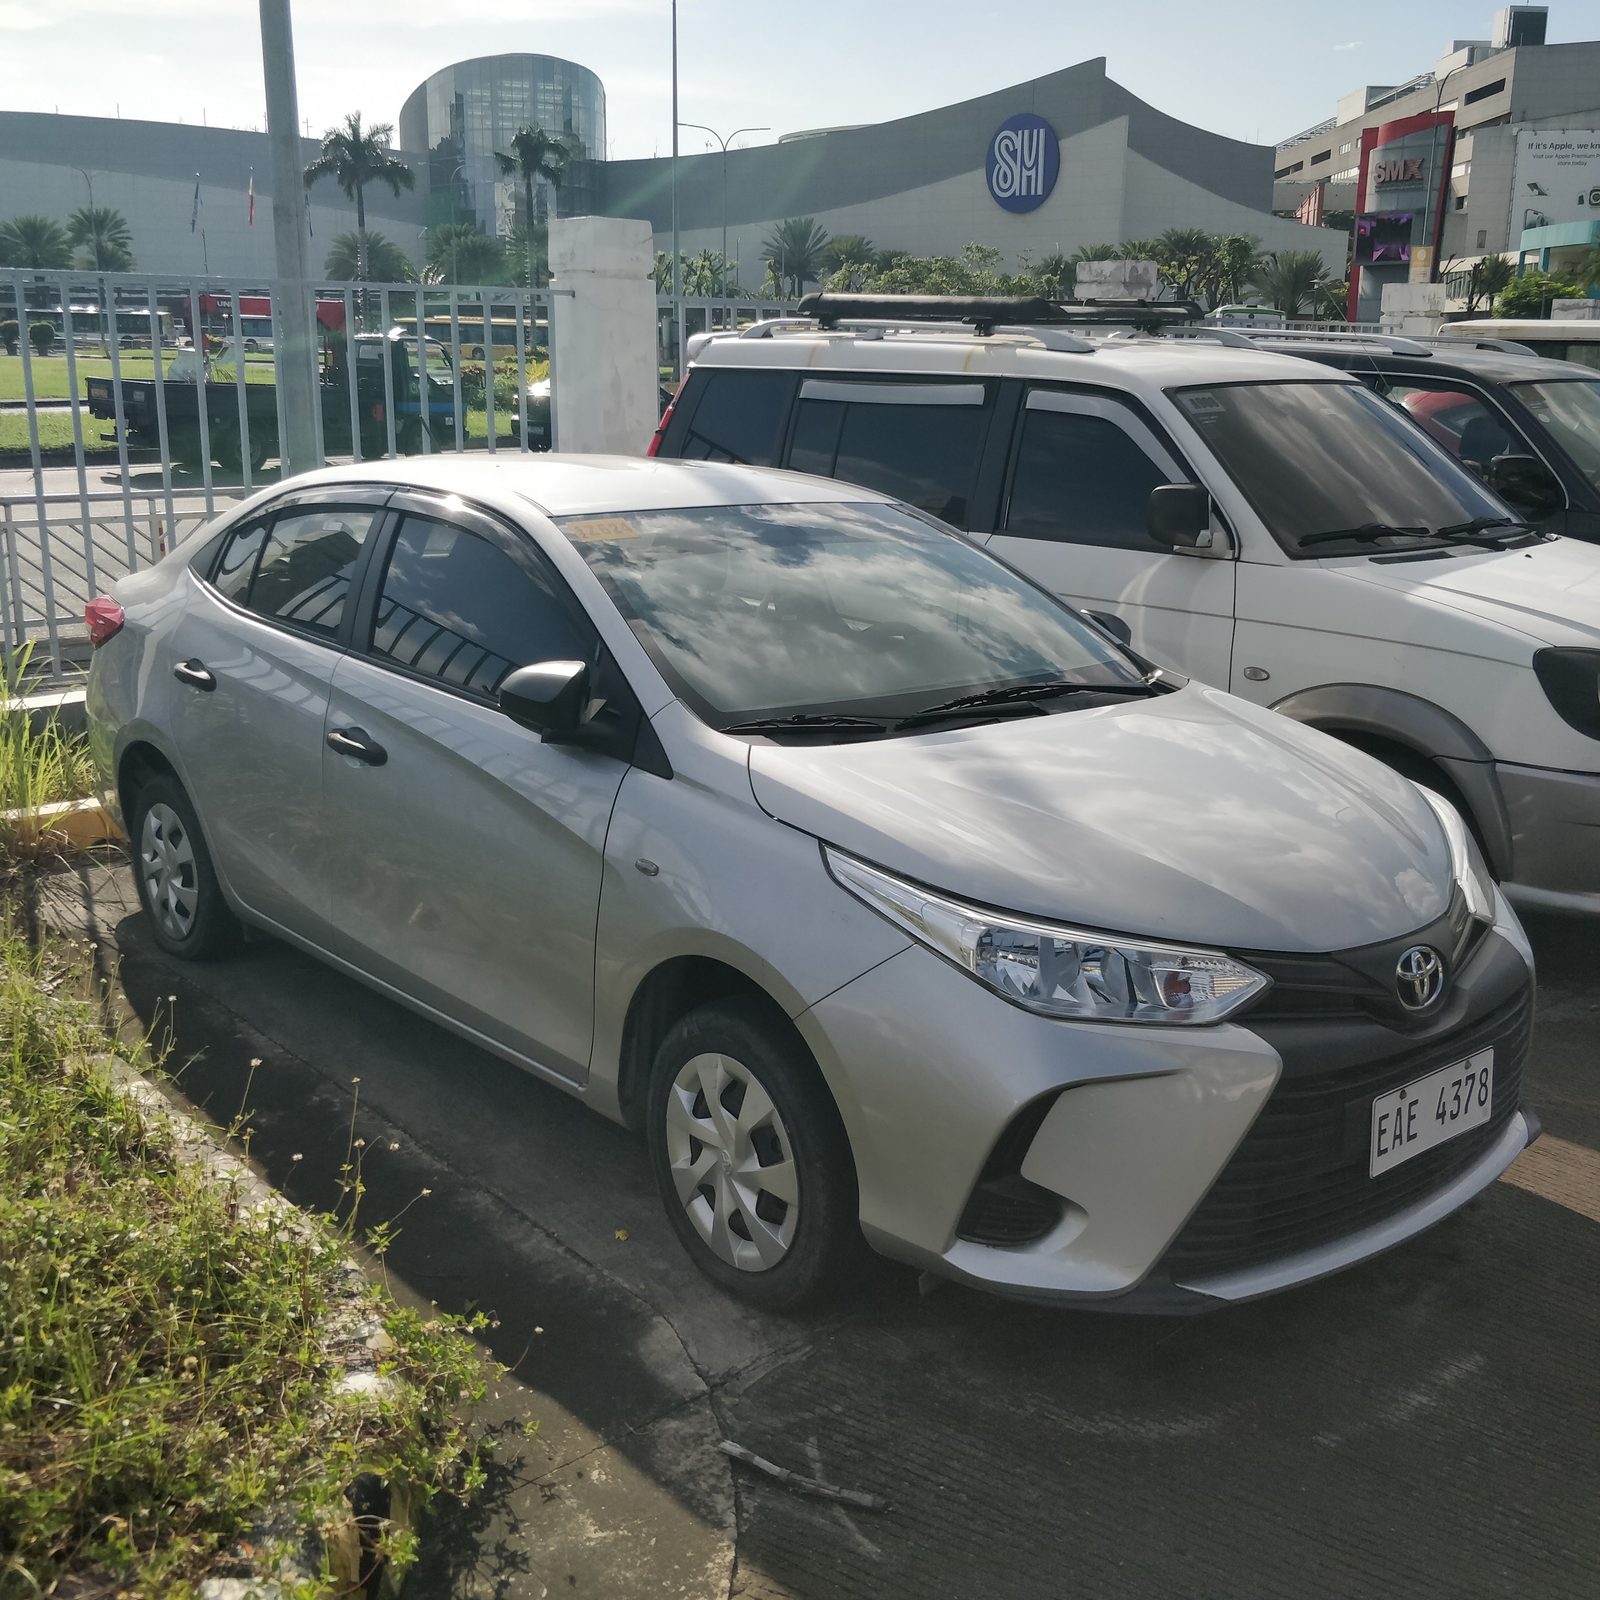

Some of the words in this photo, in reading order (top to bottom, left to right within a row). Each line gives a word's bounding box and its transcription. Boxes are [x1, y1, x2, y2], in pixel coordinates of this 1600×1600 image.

[992, 128, 1046, 198] SM
[1527, 142, 1534, 150] If
[1535, 142, 1547, 150] it's
[1548, 141, 1575, 151] Apple,
[1374, 158, 1424, 184] SMX
[1377, 1099, 1419, 1158] EAE
[1435, 1067, 1489, 1126] 4378
